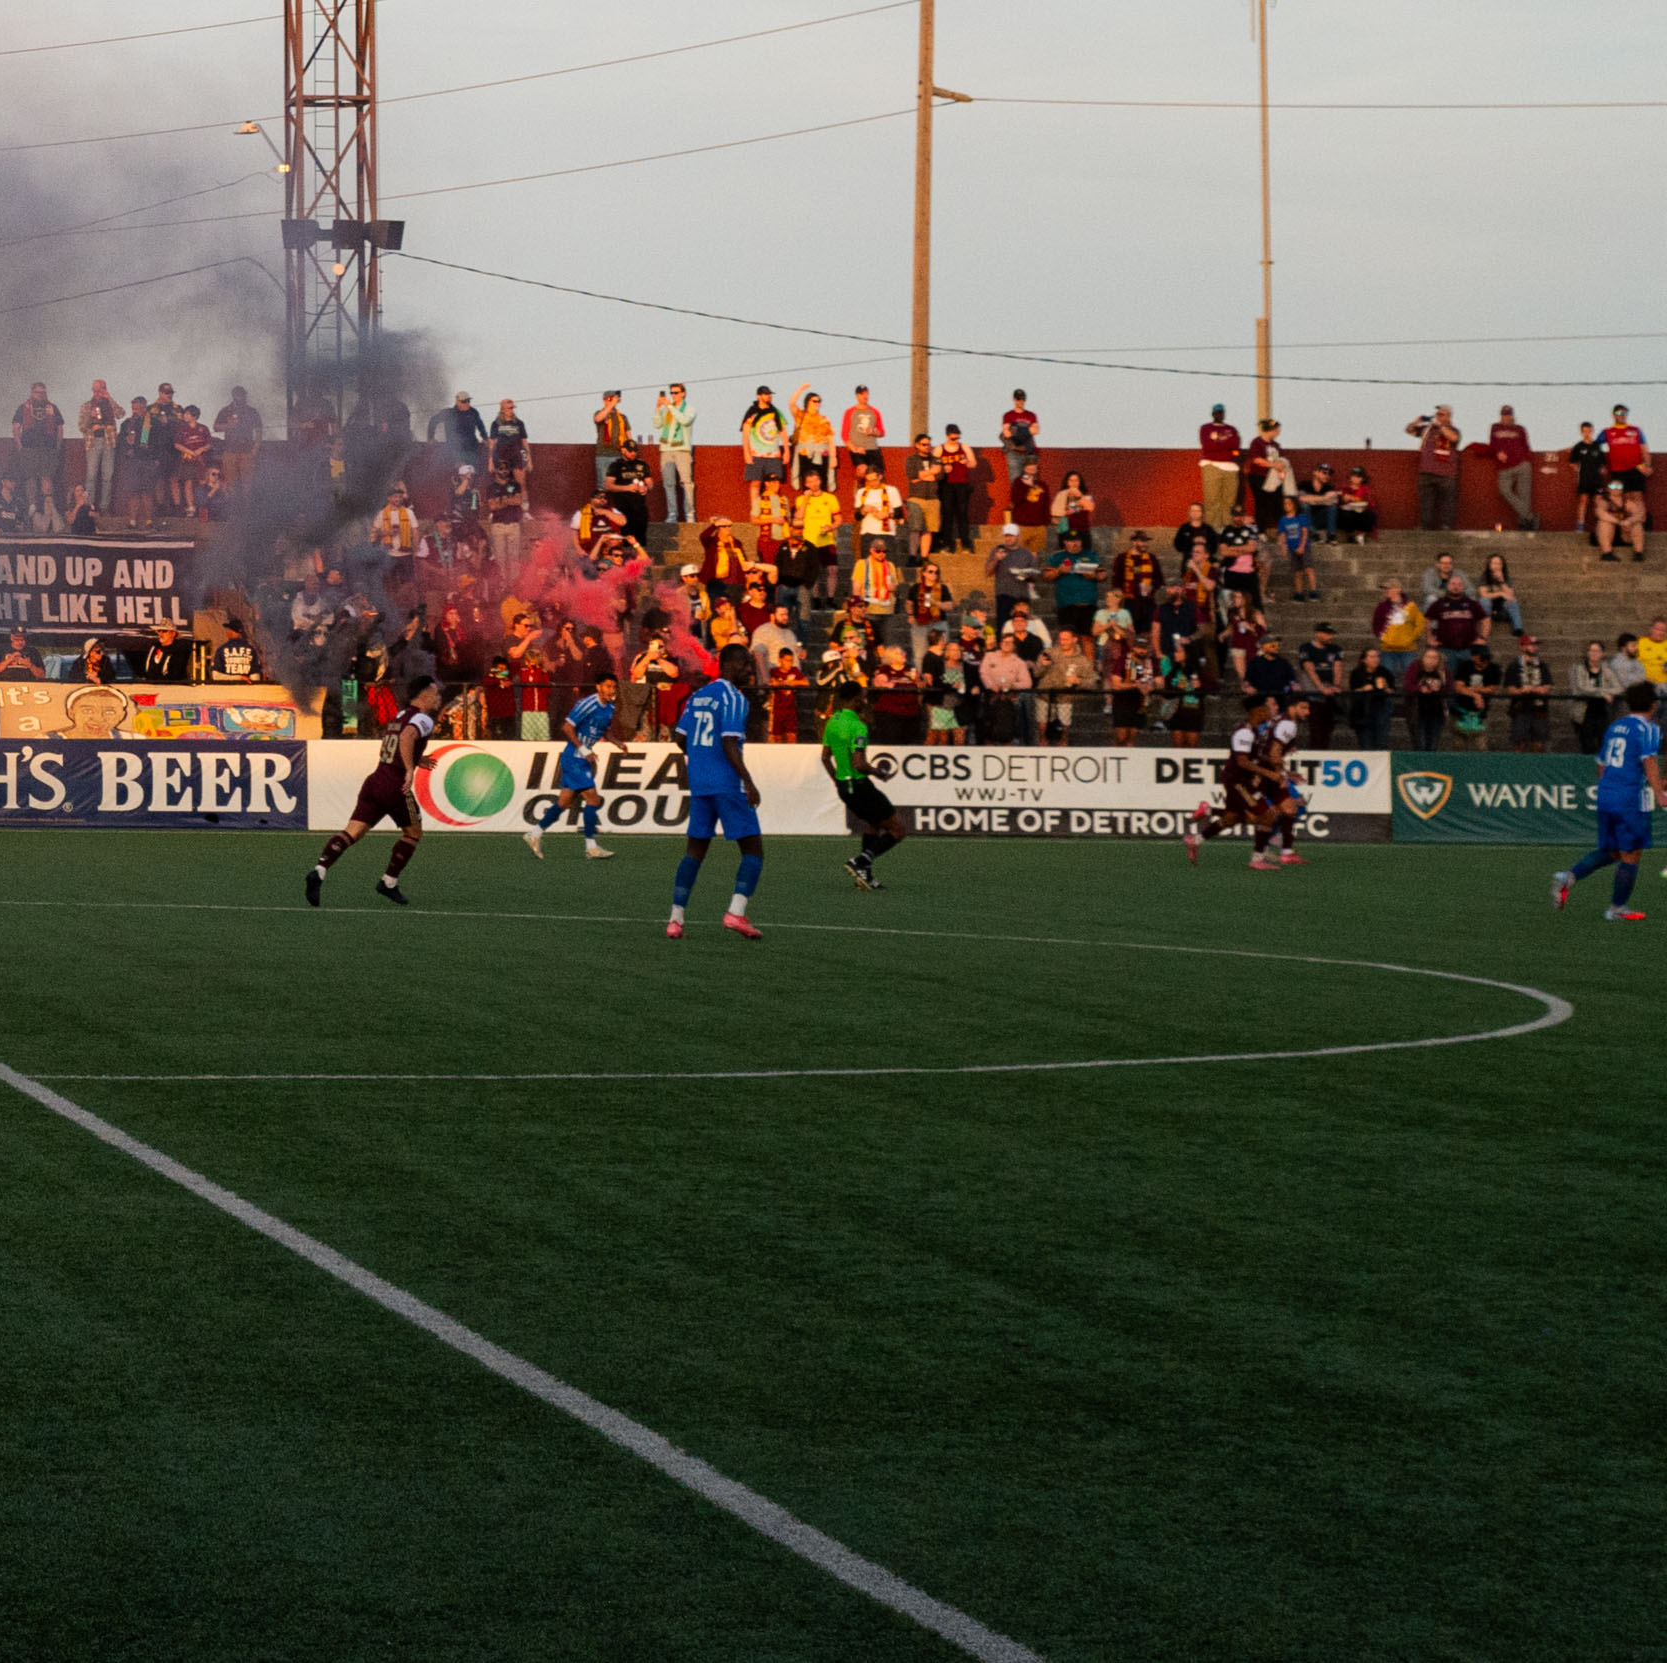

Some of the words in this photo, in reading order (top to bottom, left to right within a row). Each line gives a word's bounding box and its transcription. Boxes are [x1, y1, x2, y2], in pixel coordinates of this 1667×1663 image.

[65, 555, 103, 586] UP
[113, 559, 174, 589] AND
[41, 593, 108, 624] LIKE
[116, 595, 188, 626] HELL
[19, 714, 42, 732] a
[692, 711, 715, 747] 72
[1604, 737, 1627, 768] 13
[97, 751, 298, 814] BEER
[902, 754, 971, 781] CBS
[983, 755, 1129, 783] DETROIT
[1155, 757, 1368, 788] DETT50
[522, 794, 691, 826] GROU
[955, 787, 1044, 802] WWJ-TV
[1467, 782, 1578, 810] WAYNE
[915, 808, 1010, 831] HOME
[1017, 809, 1062, 833] OF
[1070, 810, 1197, 835] DETROIT
